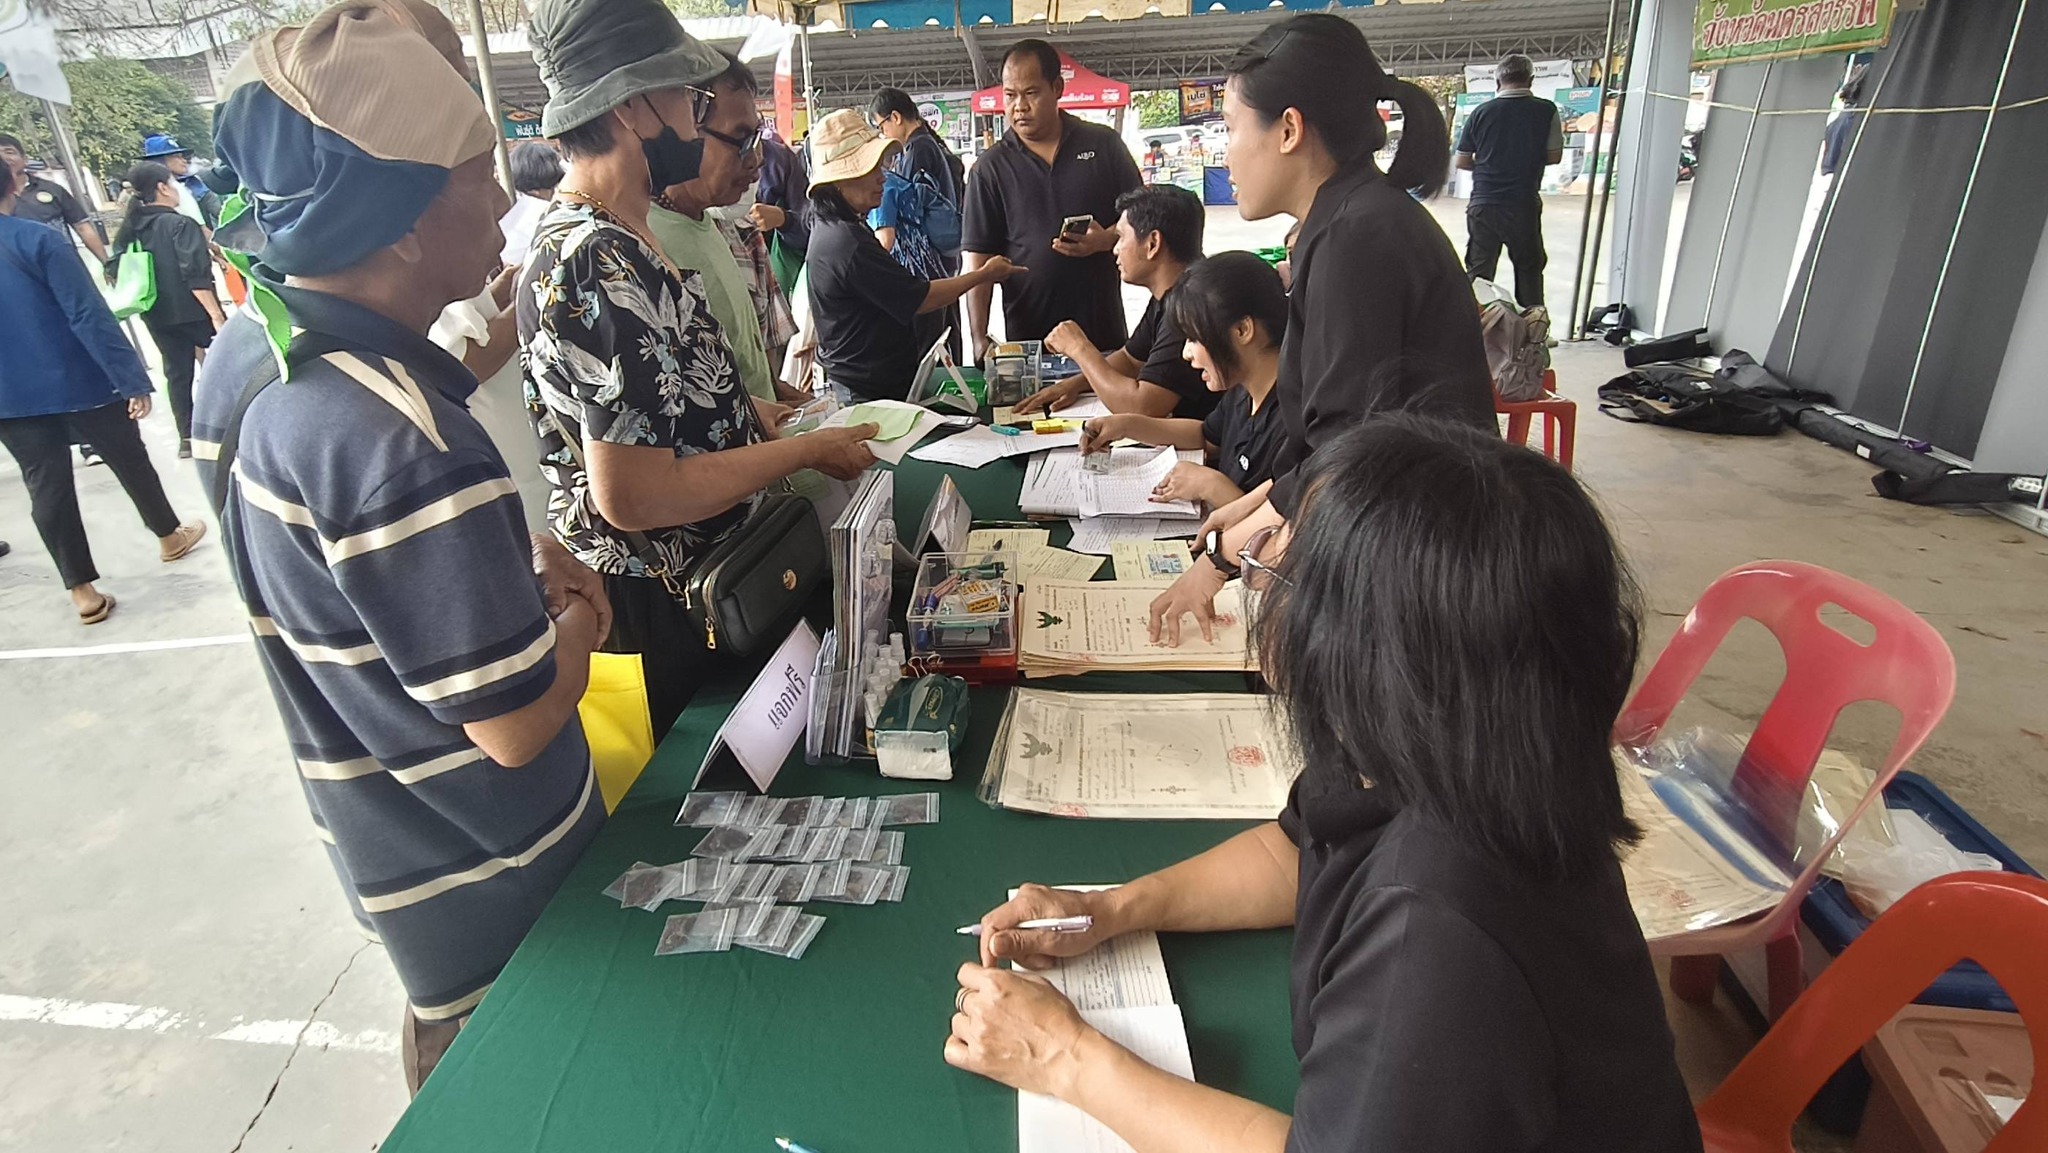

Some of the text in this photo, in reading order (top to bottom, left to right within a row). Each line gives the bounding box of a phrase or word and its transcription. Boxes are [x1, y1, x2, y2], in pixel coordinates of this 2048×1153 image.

[1702, 0, 1877, 48] จังหวัดนครสวรรค
[767, 663, 807, 730] แจกฟรี
